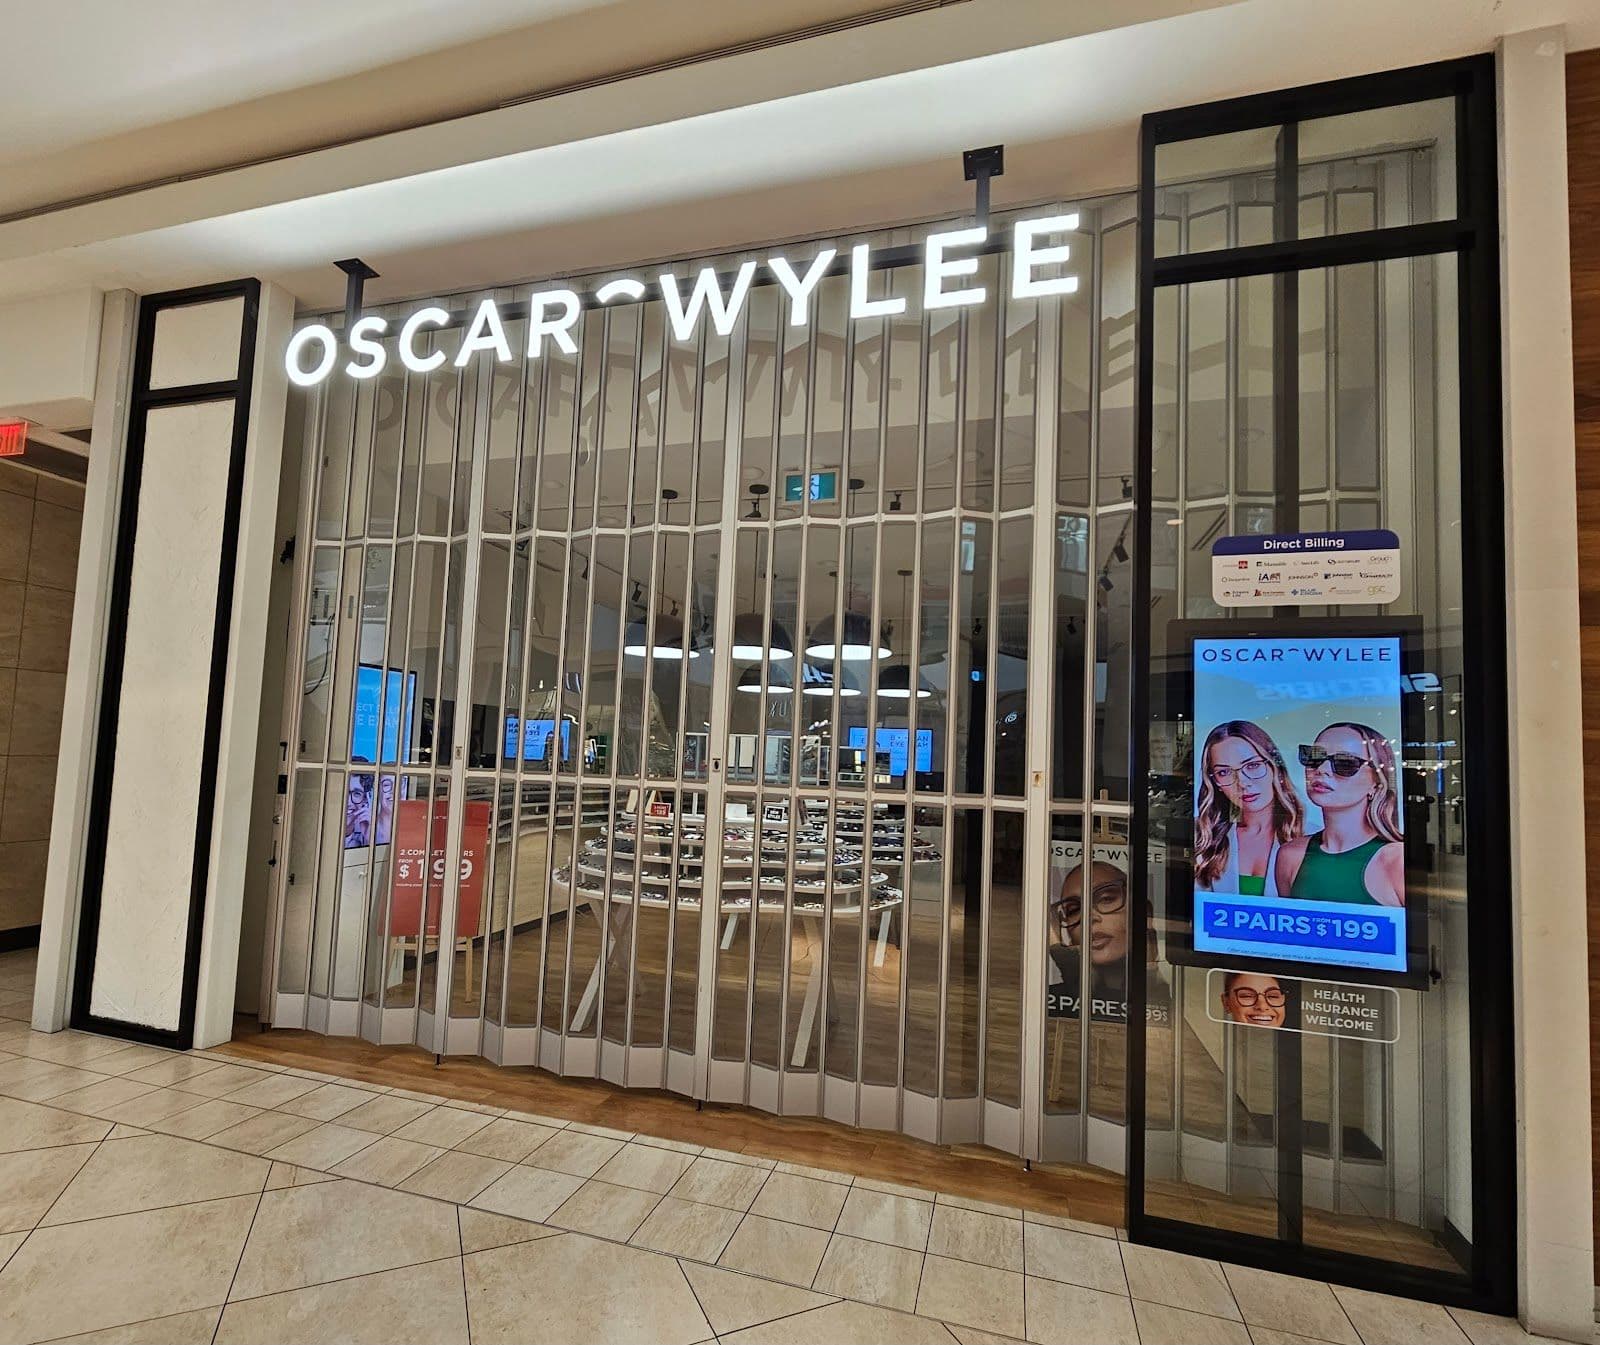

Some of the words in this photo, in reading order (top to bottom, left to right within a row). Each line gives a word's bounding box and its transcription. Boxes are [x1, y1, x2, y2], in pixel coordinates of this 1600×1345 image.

[284, 289, 581, 388] OSCAR
[660, 212, 1081, 342] WYLEE
[1263, 540, 1301, 550] Direct
[1304, 537, 1345, 549] Billing
[1202, 648, 1284, 662] OSCAR
[1303, 647, 1392, 662] WYLEE
[1213, 909, 1228, 927] 2
[1234, 910, 1312, 935] PAIRS
[1332, 918, 1379, 941] 199
[1047, 994, 1057, 1010] 2
[1059, 995, 1128, 1018] PARES
[1313, 989, 1365, 1004] HEALTH
[1301, 1000, 1379, 1019] INSURANCE
[1305, 1014, 1374, 1031] WELCOME
